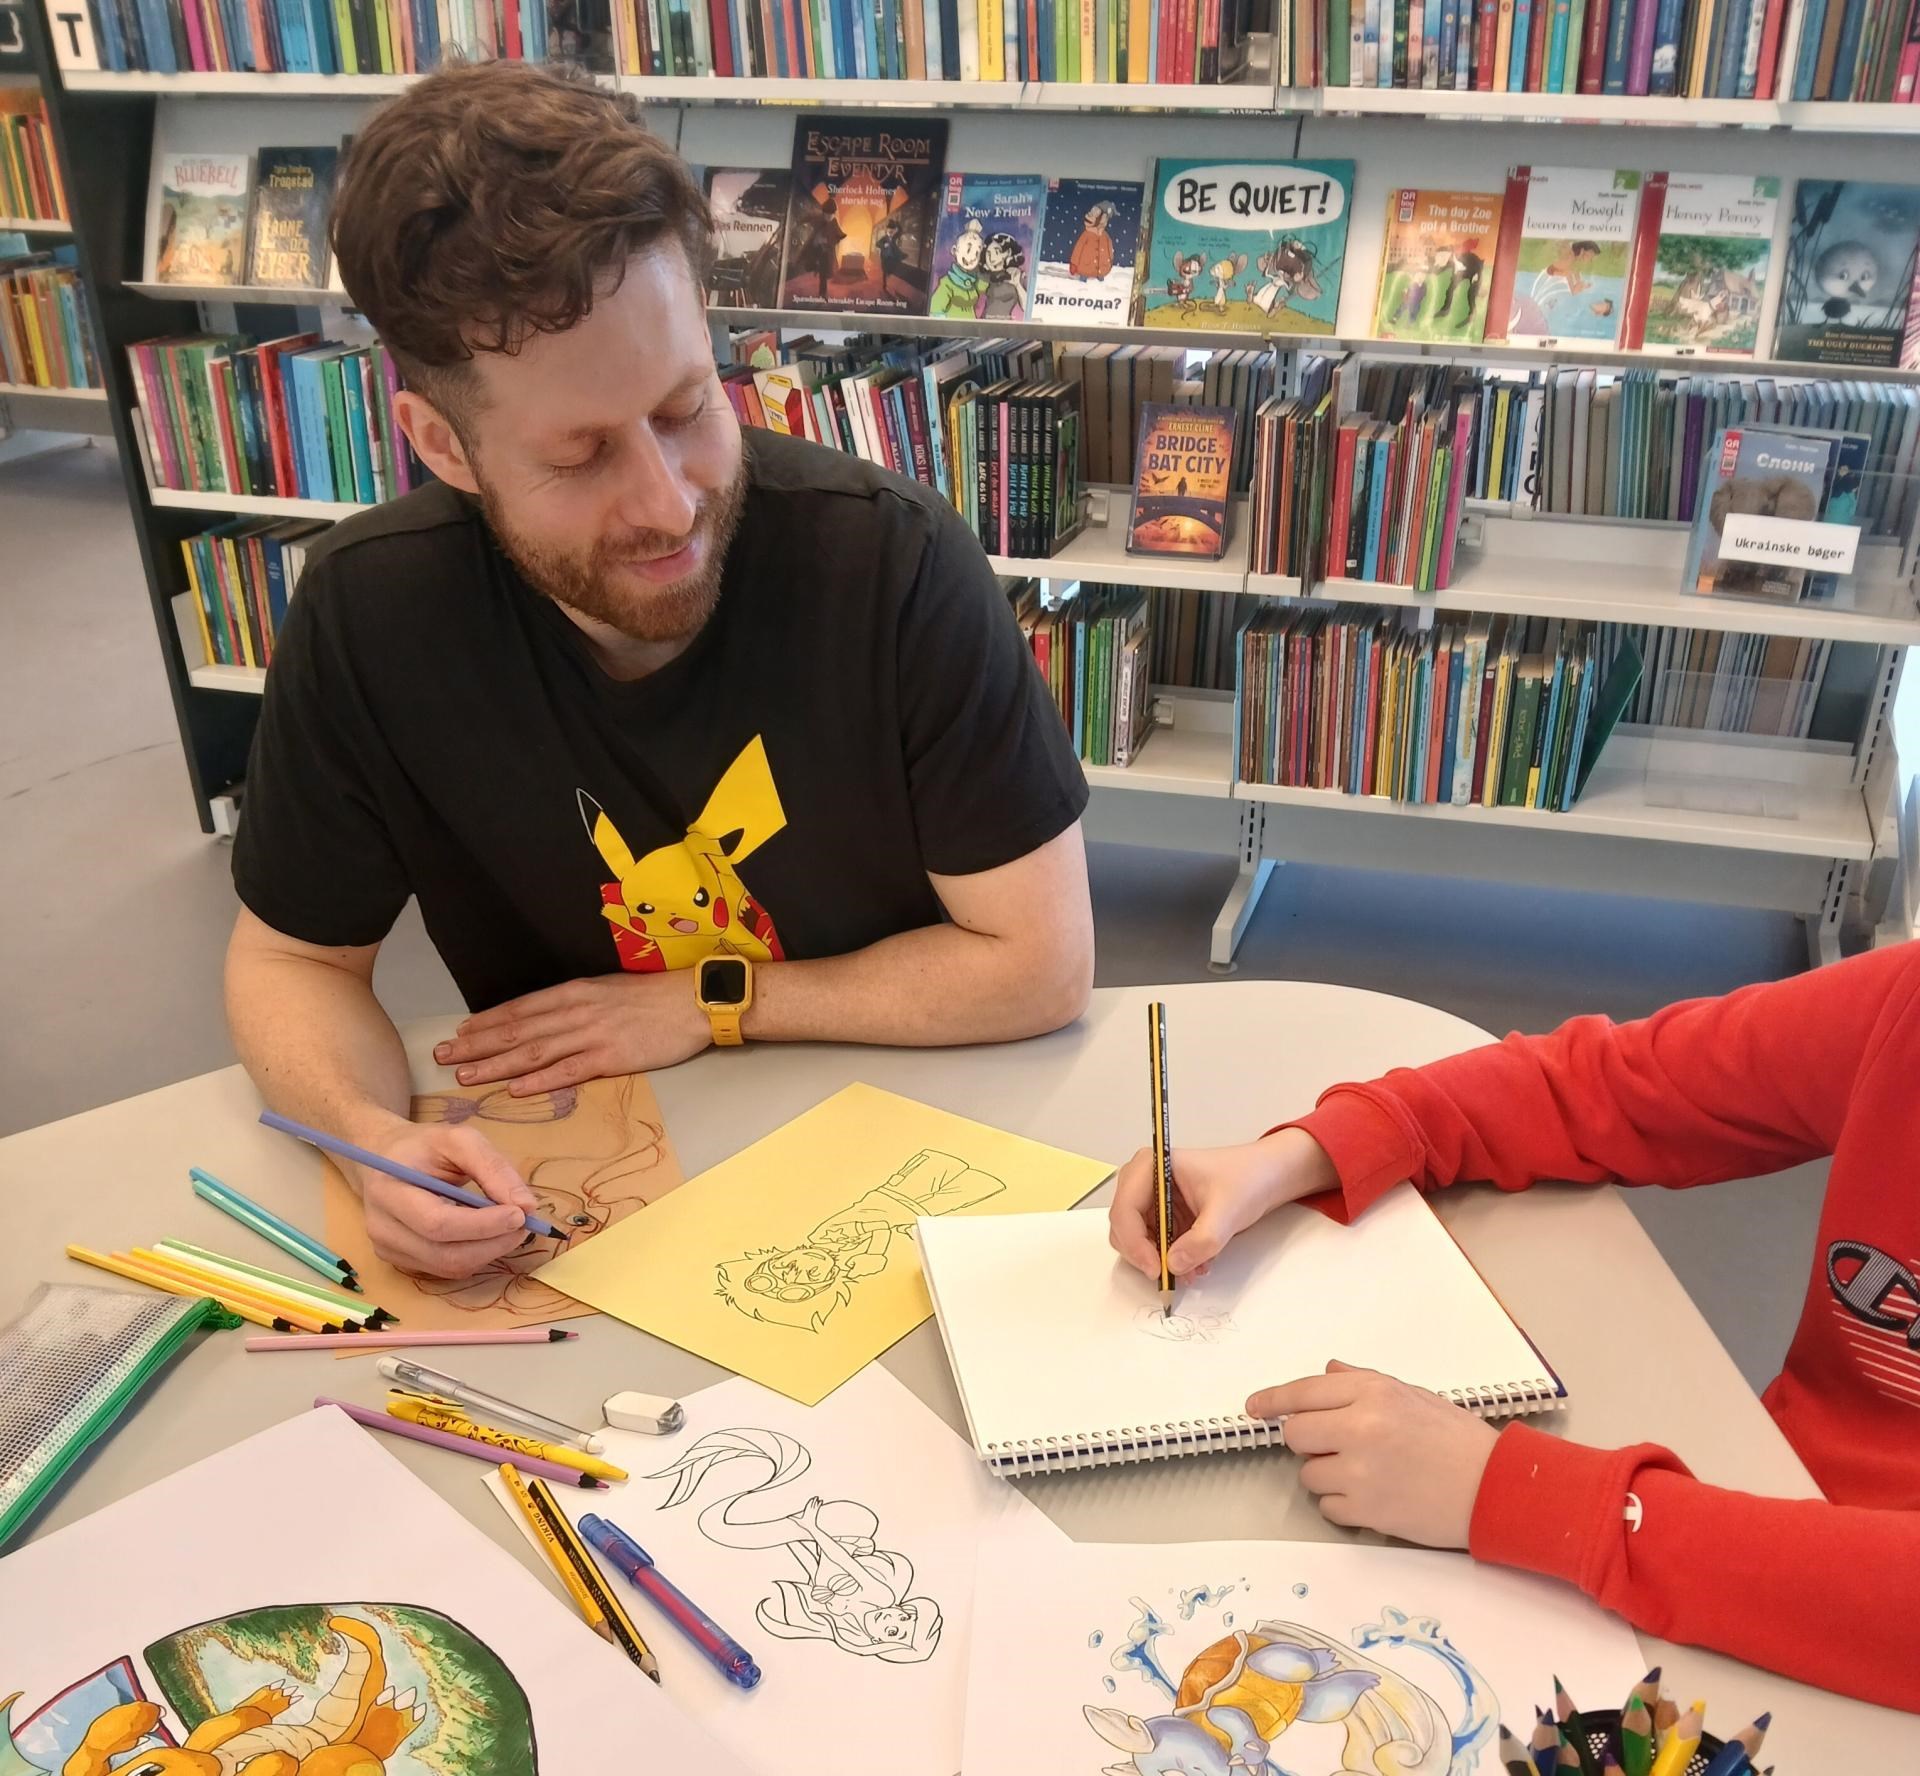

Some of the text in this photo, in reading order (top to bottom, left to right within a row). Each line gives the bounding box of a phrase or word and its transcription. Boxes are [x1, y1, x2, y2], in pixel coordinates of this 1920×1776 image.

[56, 12, 83, 58] T
[807, 130, 931, 160] ESCAPE ROOM
[175, 165, 240, 188] BLUEBELL
[827, 156, 907, 184] EVENTYR
[993, 192, 1033, 205] Sarah's
[1177, 178, 1332, 217] BE QUIET!
[965, 205, 1032, 219] New Friend
[1429, 205, 1493, 220] The day Zoe
[1571, 199, 1624, 221] Mowgli
[1666, 204, 1763, 229] Henny Penny
[733, 220, 774, 233] Rennen
[1420, 220, 1438, 233] got
[1450, 221, 1491, 234] Brother
[1527, 216, 1623, 233] learns to swim
[1034, 293, 1122, 311] Як погода?
[1155, 434, 1217, 454] BRIDGE
[1147, 453, 1226, 475] BAT CITY
[1756, 452, 1816, 474] Слони
[1735, 537, 1846, 560] Ukrainske bøger
[532, 1511, 555, 1544] VIKING
